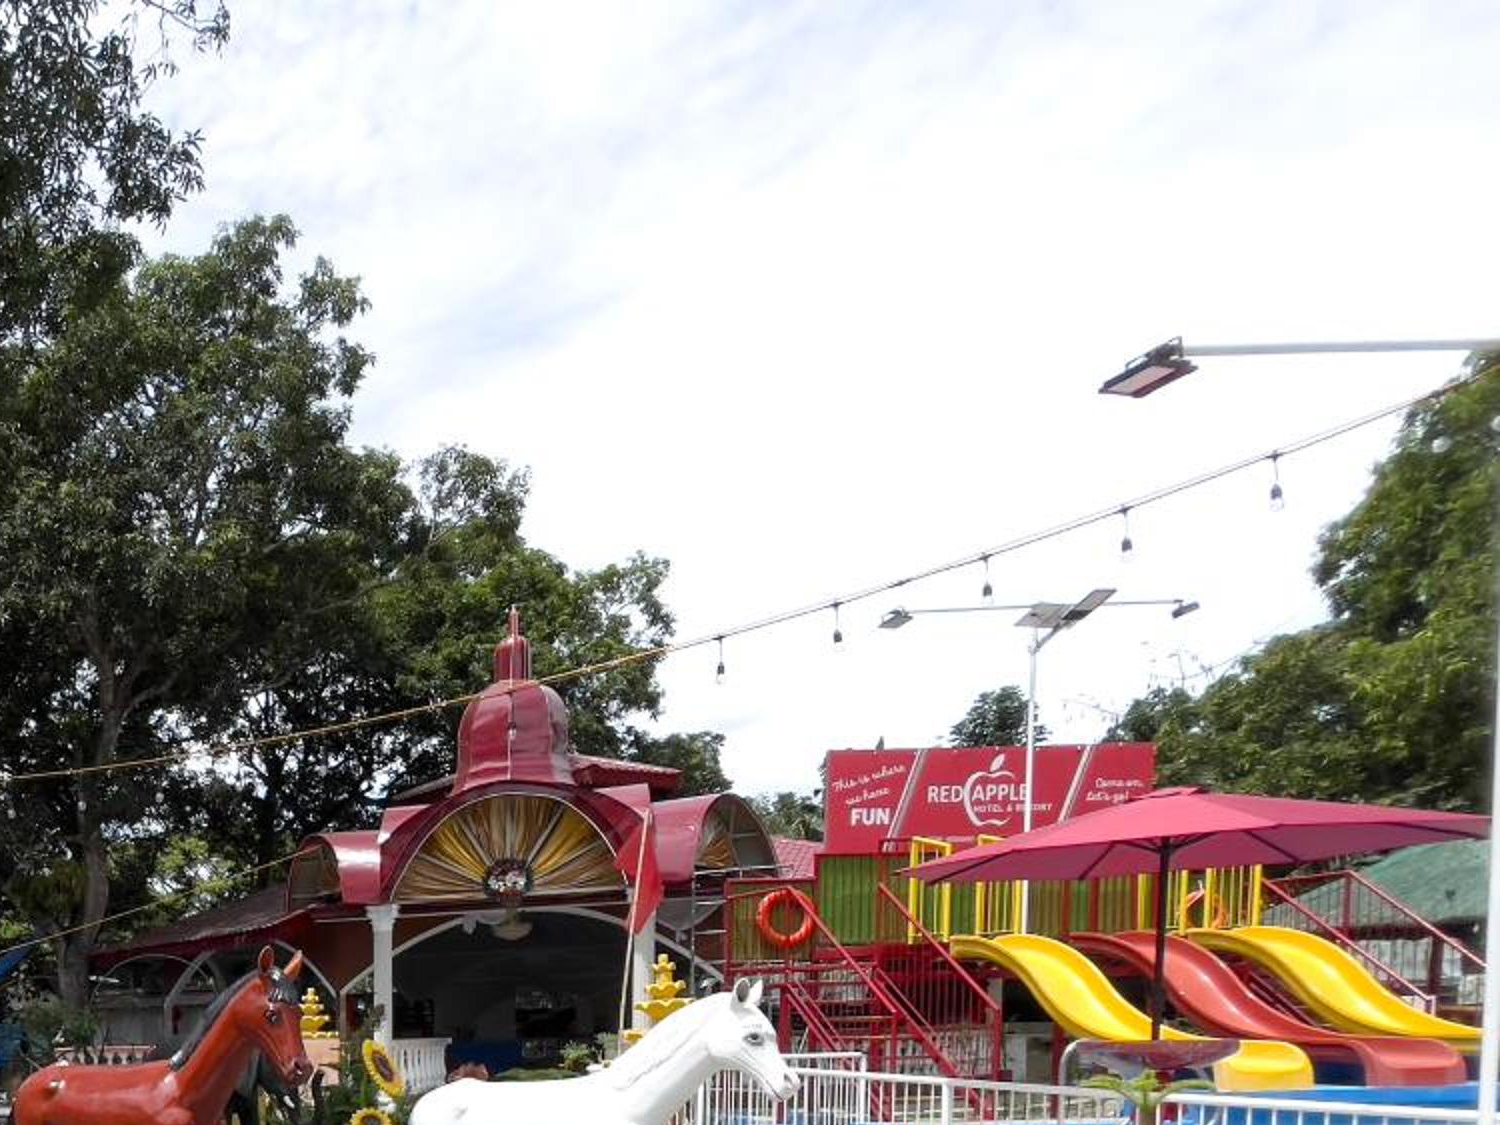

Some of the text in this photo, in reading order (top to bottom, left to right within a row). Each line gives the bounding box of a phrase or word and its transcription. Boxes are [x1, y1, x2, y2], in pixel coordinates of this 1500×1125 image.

[927, 783, 1027, 803] RED APPLE
[851, 807, 891, 827] FUN
[973, 803, 1005, 813] HOTEL
